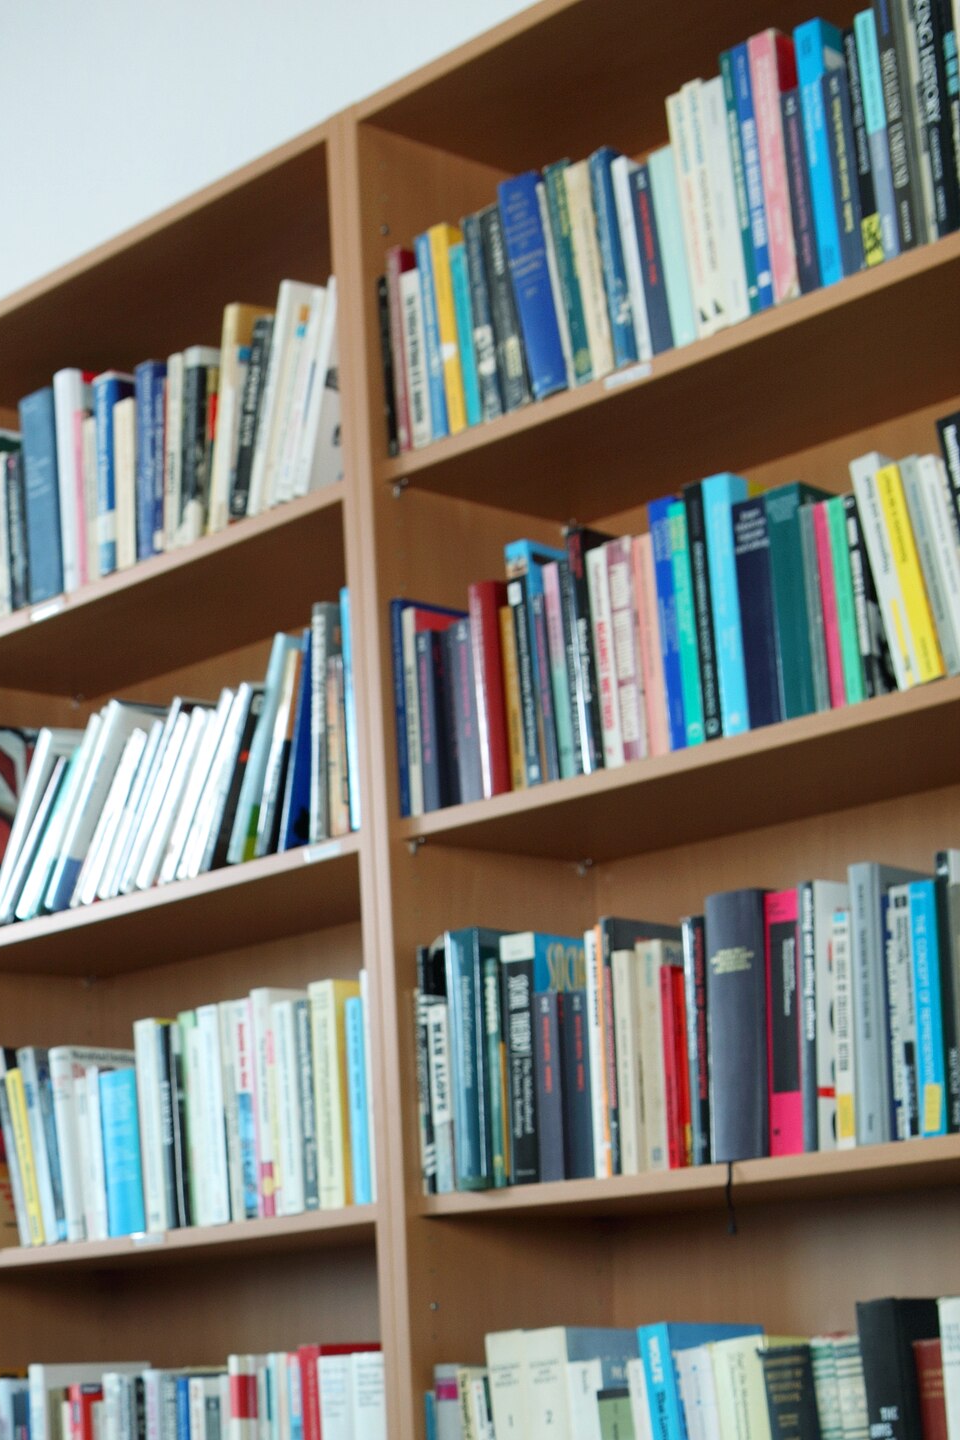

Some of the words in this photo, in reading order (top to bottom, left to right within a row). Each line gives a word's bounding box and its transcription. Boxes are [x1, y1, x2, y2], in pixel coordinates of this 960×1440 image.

[920, 47, 941, 123] HISTORY
[802, 888, 813, 931] making
[915, 914, 926, 934] THE
[804, 934, 814, 955] and
[915, 939, 929, 988] CONCEPT
[508, 974, 530, 1010] SOCIAL
[803, 958, 815, 997] selling
[919, 990, 930, 1004] OF
[510, 1012, 532, 1052] THEORY
[806, 998, 816, 1040] culture
[436, 1063, 446, 1111] ALONE
[647, 1336, 664, 1383] WOLFE
[656, 1390, 666, 1414] The
[879, 1406, 899, 1421] THE
